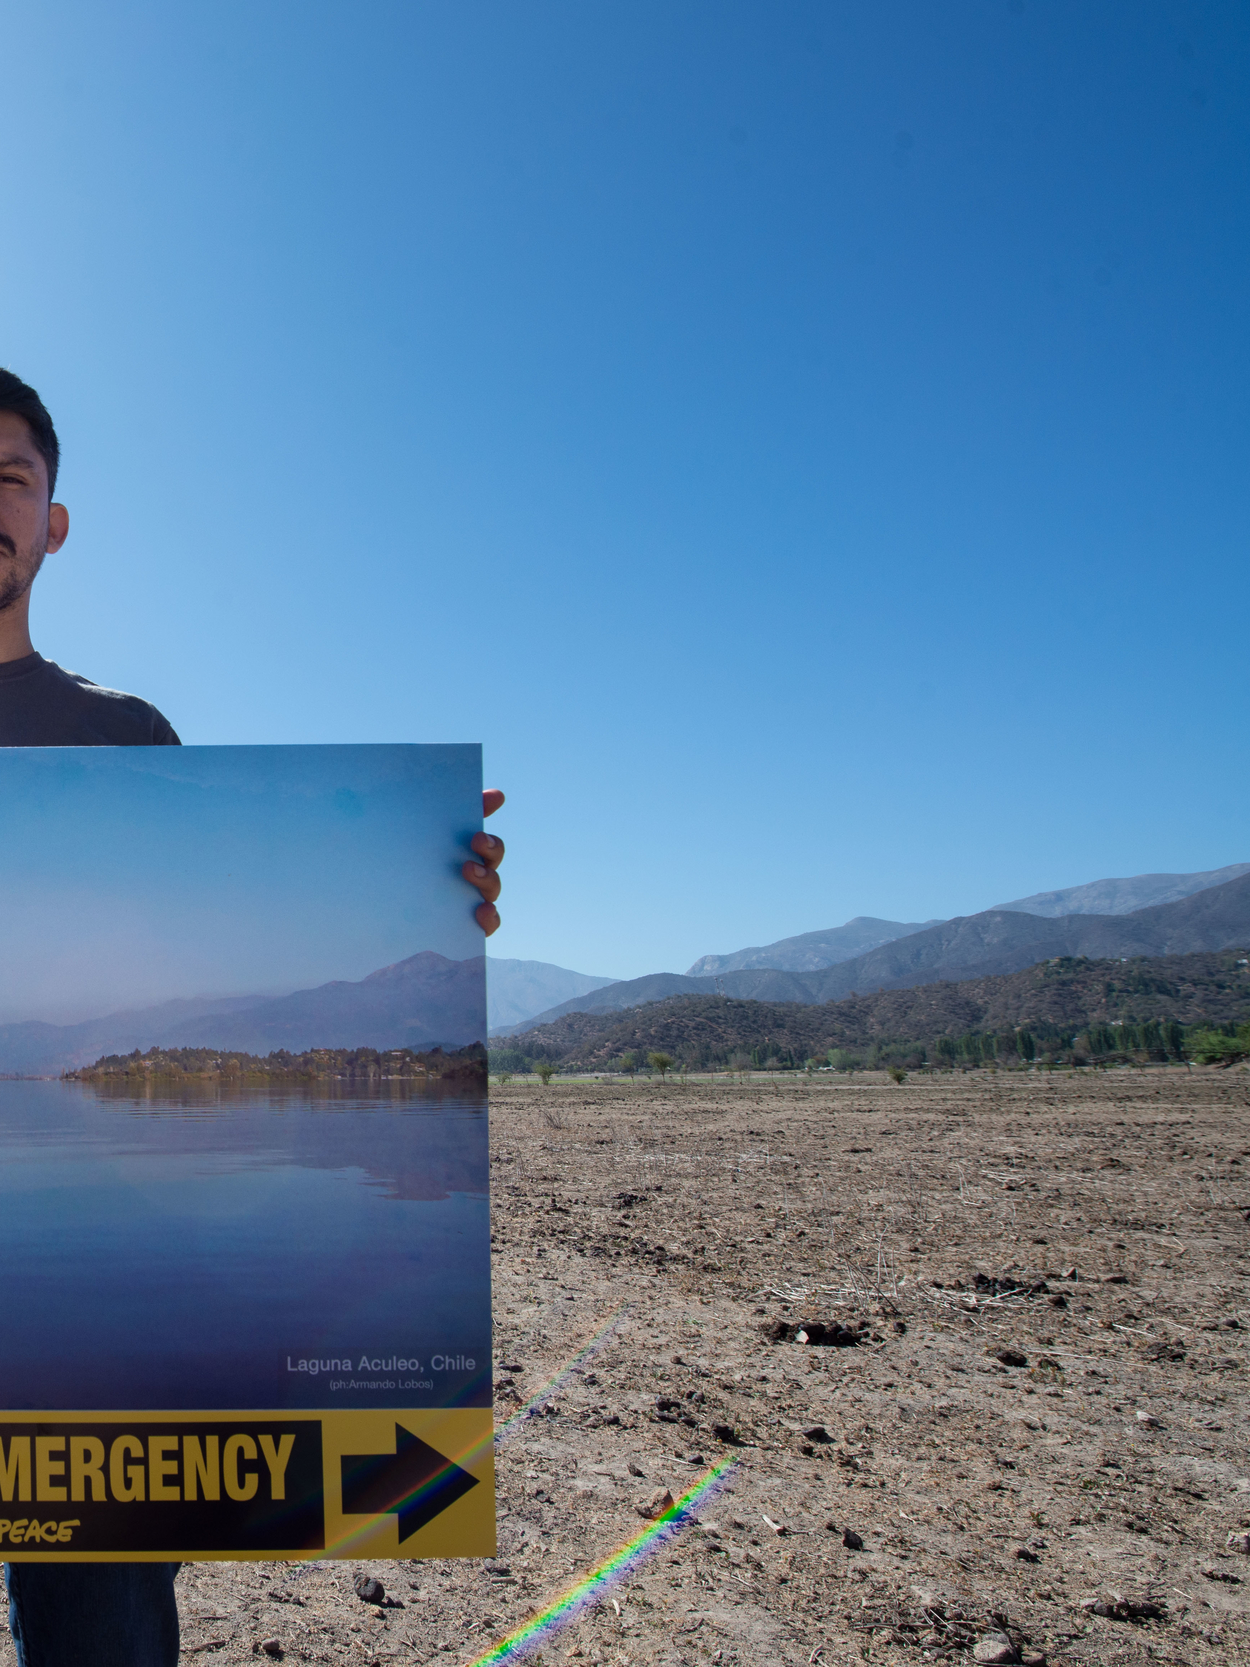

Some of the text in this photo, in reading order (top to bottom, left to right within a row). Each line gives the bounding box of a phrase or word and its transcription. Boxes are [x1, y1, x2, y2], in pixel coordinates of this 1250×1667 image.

[286, 1354, 476, 1375] Laguna Aculeo, Chile
[398, 1379, 434, 1391] Lobos)
